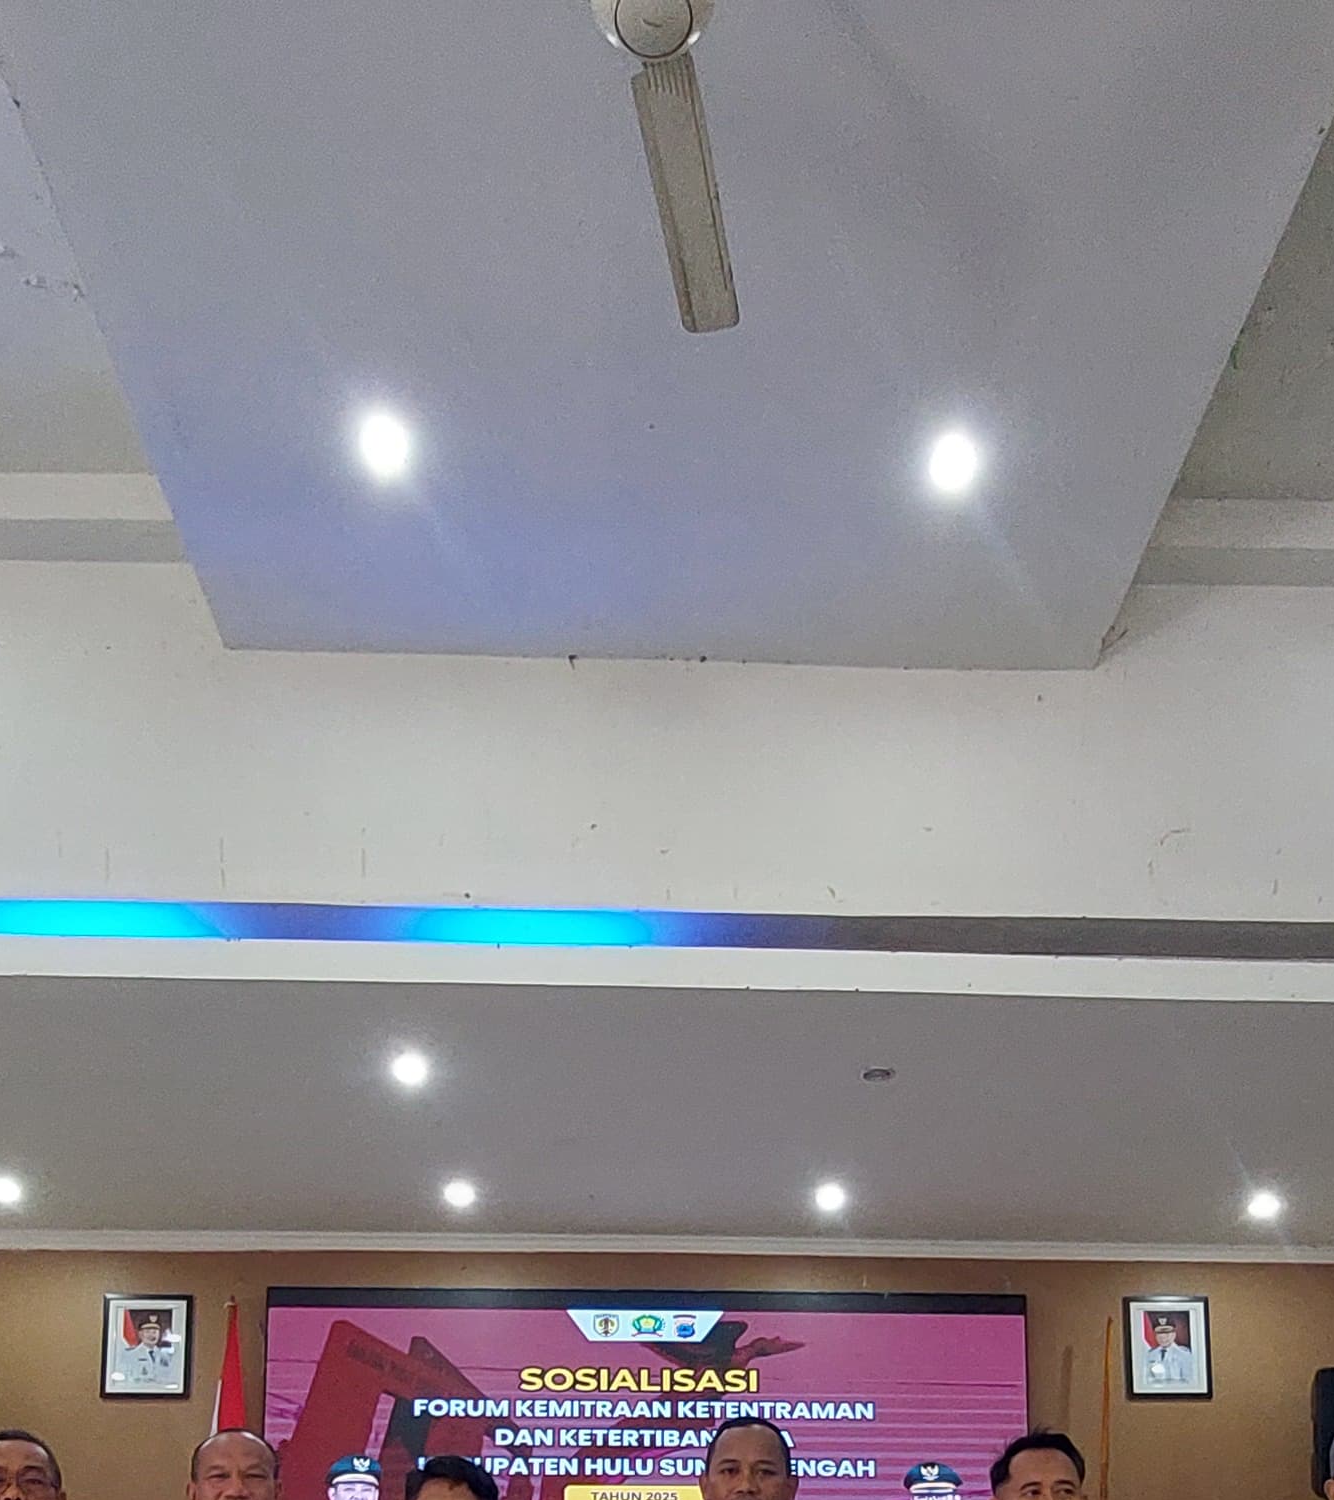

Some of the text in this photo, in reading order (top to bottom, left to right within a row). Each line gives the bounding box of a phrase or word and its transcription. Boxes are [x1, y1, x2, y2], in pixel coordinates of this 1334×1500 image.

[520, 1368, 758, 1392] SOSIALISASI
[413, 1399, 875, 1420] FORUM KEMITRAAN KETENTRAMAN
[495, 1429, 717, 1447] DAN KETERTIBAN
[418, 1457, 876, 1477] UPATEN HULU SUN ENGAH
